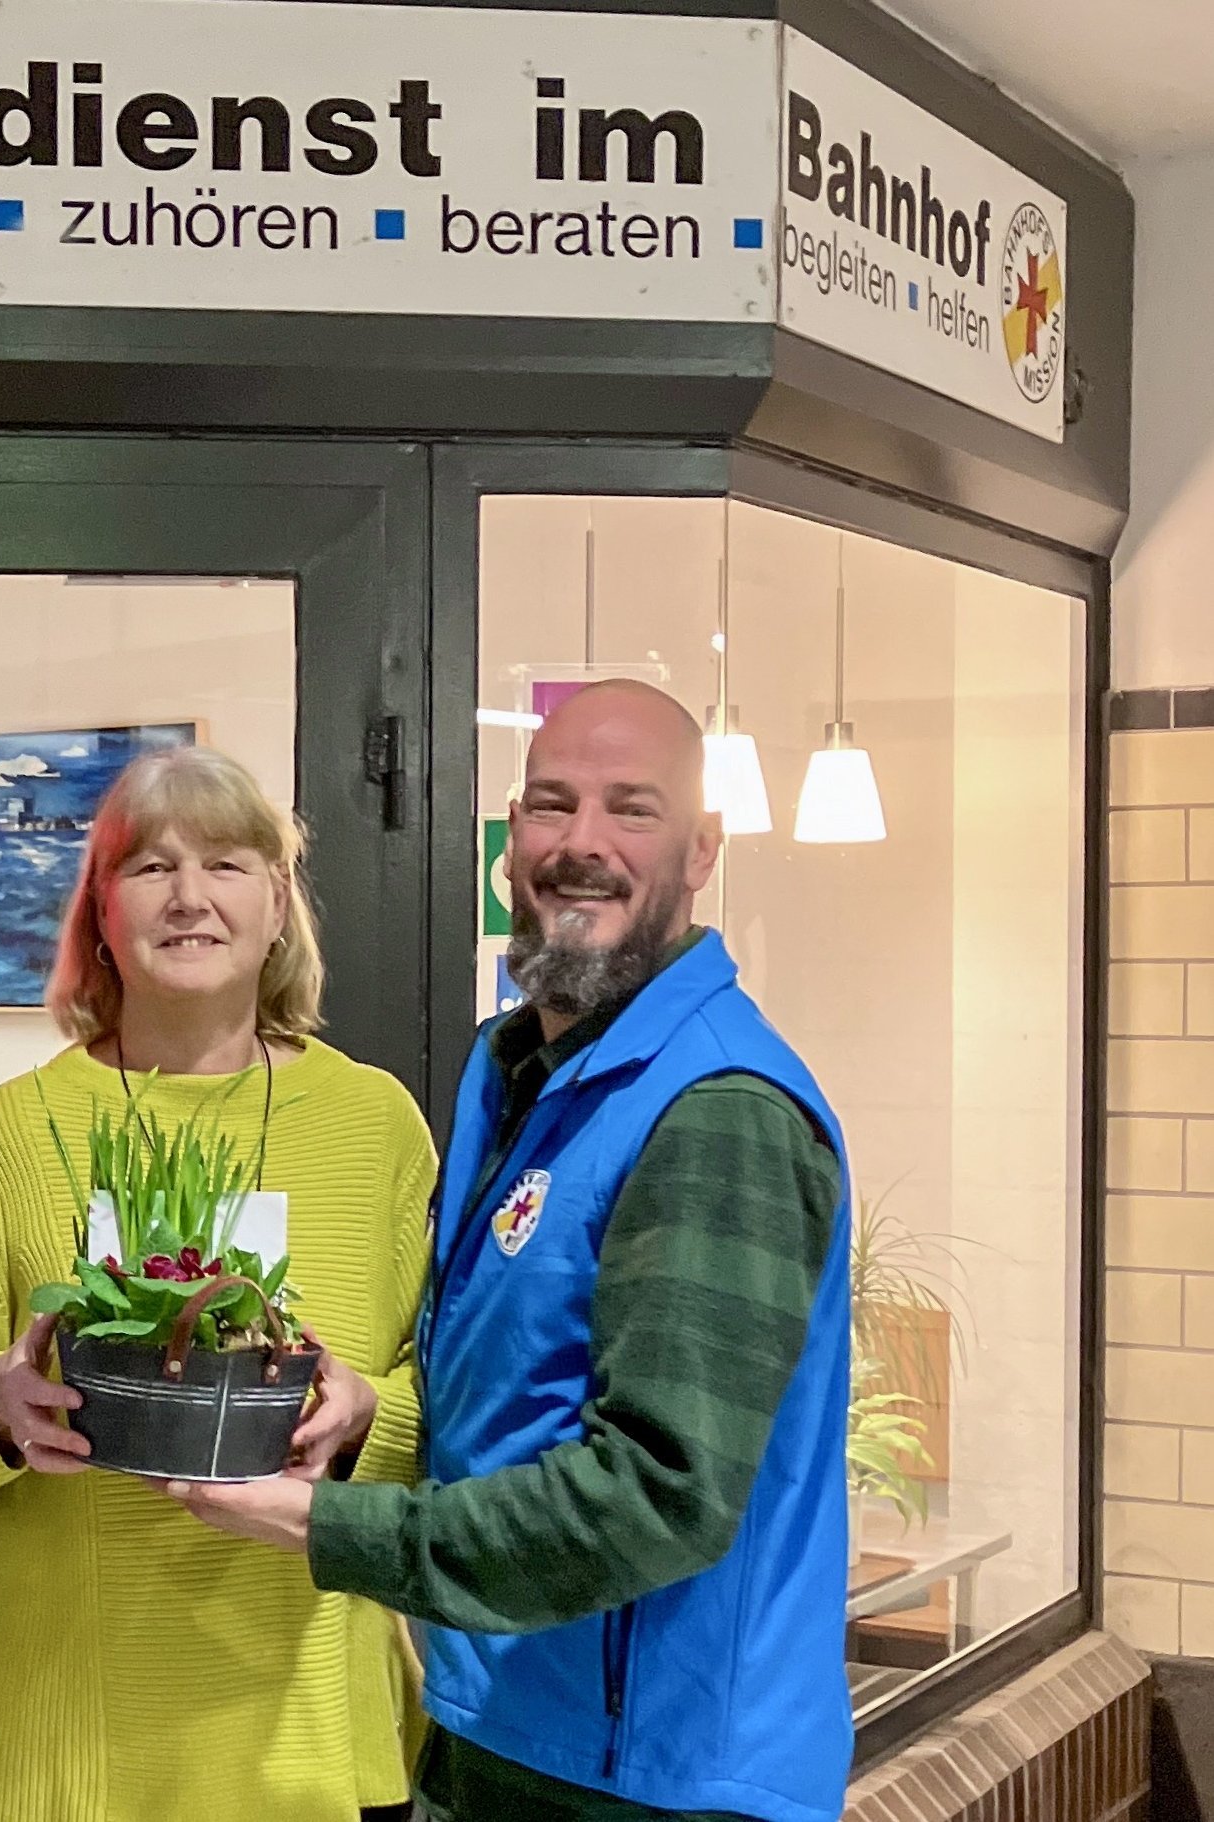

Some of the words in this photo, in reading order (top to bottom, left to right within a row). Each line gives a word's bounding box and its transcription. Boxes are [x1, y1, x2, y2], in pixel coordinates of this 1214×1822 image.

[535, 77, 704, 185] im
[59, 186, 339, 250] zuhören
[441, 194, 701, 260] beraten
[788, 90, 991, 287] Bahnhof
[783, 206, 897, 311] begleiten
[927, 276, 991, 354] helfen
[1003, 209, 1052, 305] BAHNHOFS
[1023, 311, 1061, 394] MISSION
